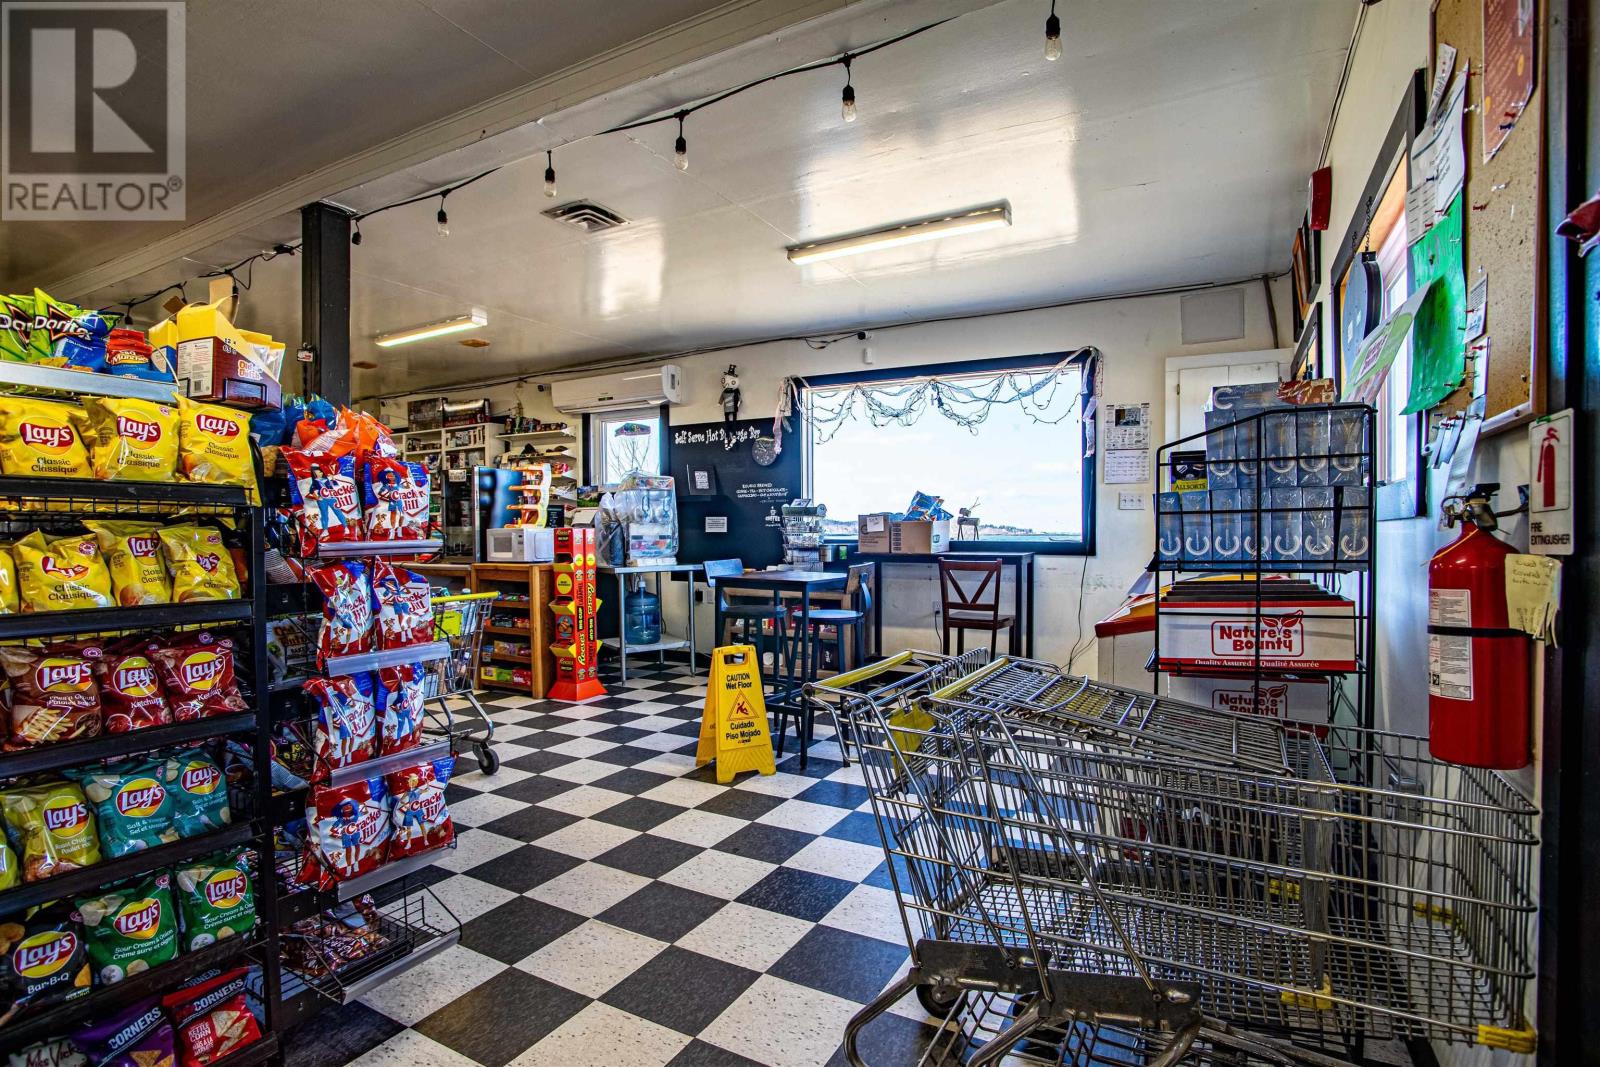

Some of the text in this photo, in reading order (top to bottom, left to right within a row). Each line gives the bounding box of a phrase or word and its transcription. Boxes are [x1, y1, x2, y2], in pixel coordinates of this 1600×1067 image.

[35, 315, 93, 340] Doritos
[119, 416, 158, 441] Lay's
[200, 415, 237, 436] Lay's
[25, 423, 71, 447] Lay's
[674, 430, 687, 444] Self
[688, 431, 705, 444] Serve
[706, 428, 719, 444] Hot
[204, 447, 240, 459] Classique
[37, 457, 71, 465] Classic
[32, 464, 78, 475] Classique
[333, 495, 353, 508] Jill
[402, 499, 419, 512] Jill
[1531, 522, 1543, 533] FIRE
[1531, 534, 1571, 546] EXTINGUISHER
[408, 600, 425, 612] Jill
[1219, 625, 1292, 640] Nature's
[1232, 640, 1293, 652] Bounty
[1222, 659, 1252, 667] Assured
[1260, 659, 1320, 668] Qualité Assurée
[43, 661, 92, 688] Lay's
[120, 665, 154, 690] Lay's
[185, 658, 224, 684] Lay's
[726, 673, 750, 682] CAUTION
[726, 681, 752, 690] Wet Floor
[130, 698, 163, 709] Ketchup
[1219, 694, 1278, 706] Natue's
[730, 720, 755, 730] Cuidado
[726, 728, 761, 740] Piso Mojado
[186, 765, 219, 789] Lay's
[122, 784, 162, 811] Lay's
[47, 803, 87, 829] Lay's
[360, 823, 377, 843] Jill
[210, 876, 244, 902] Lay's
[120, 903, 159, 933] Lay's
[220, 908, 239, 919] Cream
[115, 945, 132, 954] Sour
[132, 940, 156, 950] Cream
[160, 929, 174, 940] Onion
[20, 935, 72, 970] Lay's
[136, 946, 153, 955] sure
[193, 978, 244, 1012] CORNERS
[108, 1007, 162, 1049] CORNERS
[190, 1028, 212, 1043] CORN
